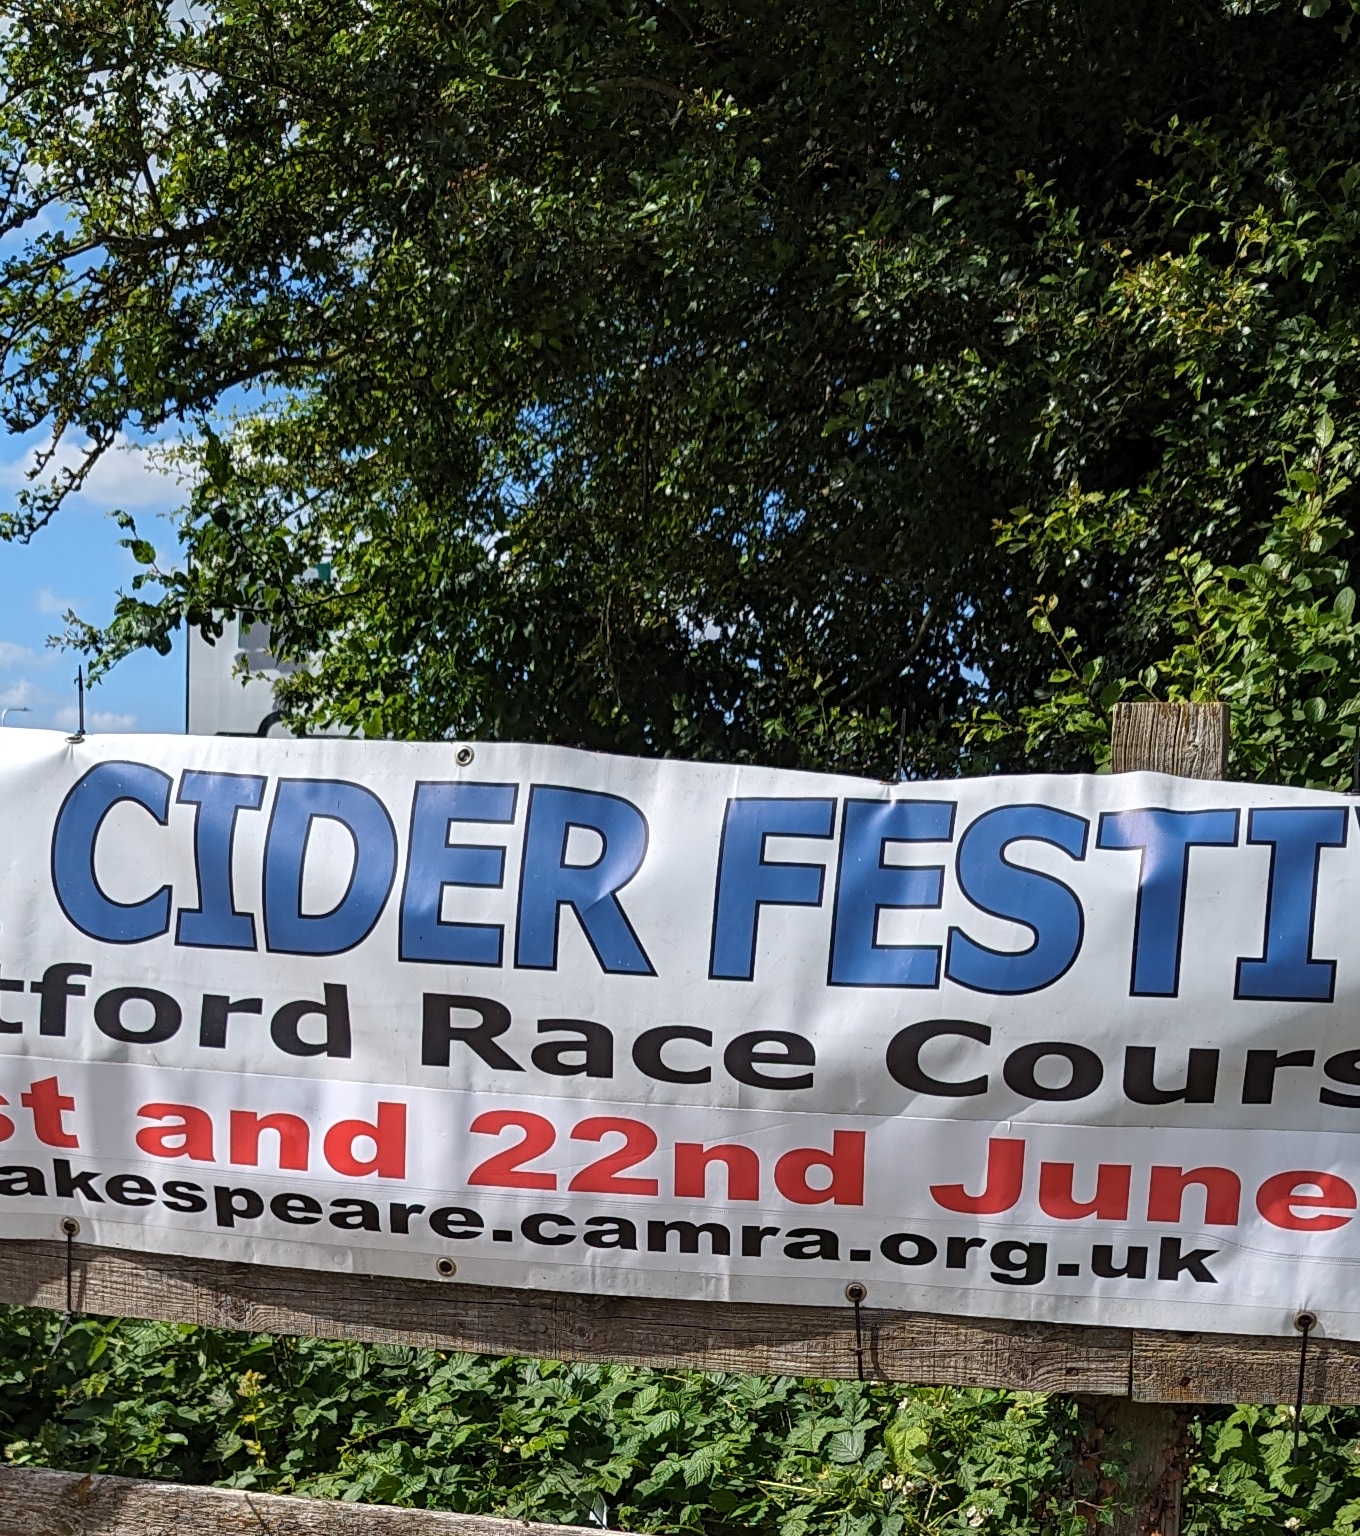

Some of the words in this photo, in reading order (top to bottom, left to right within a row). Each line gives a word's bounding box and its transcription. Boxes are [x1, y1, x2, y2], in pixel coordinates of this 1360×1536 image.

[51, 760, 659, 978] CIDER
[420, 991, 817, 1091] Race
[135, 1101, 407, 1181] and
[466, 1109, 867, 1207] 22nd
[929, 1137, 1358, 1231] June
